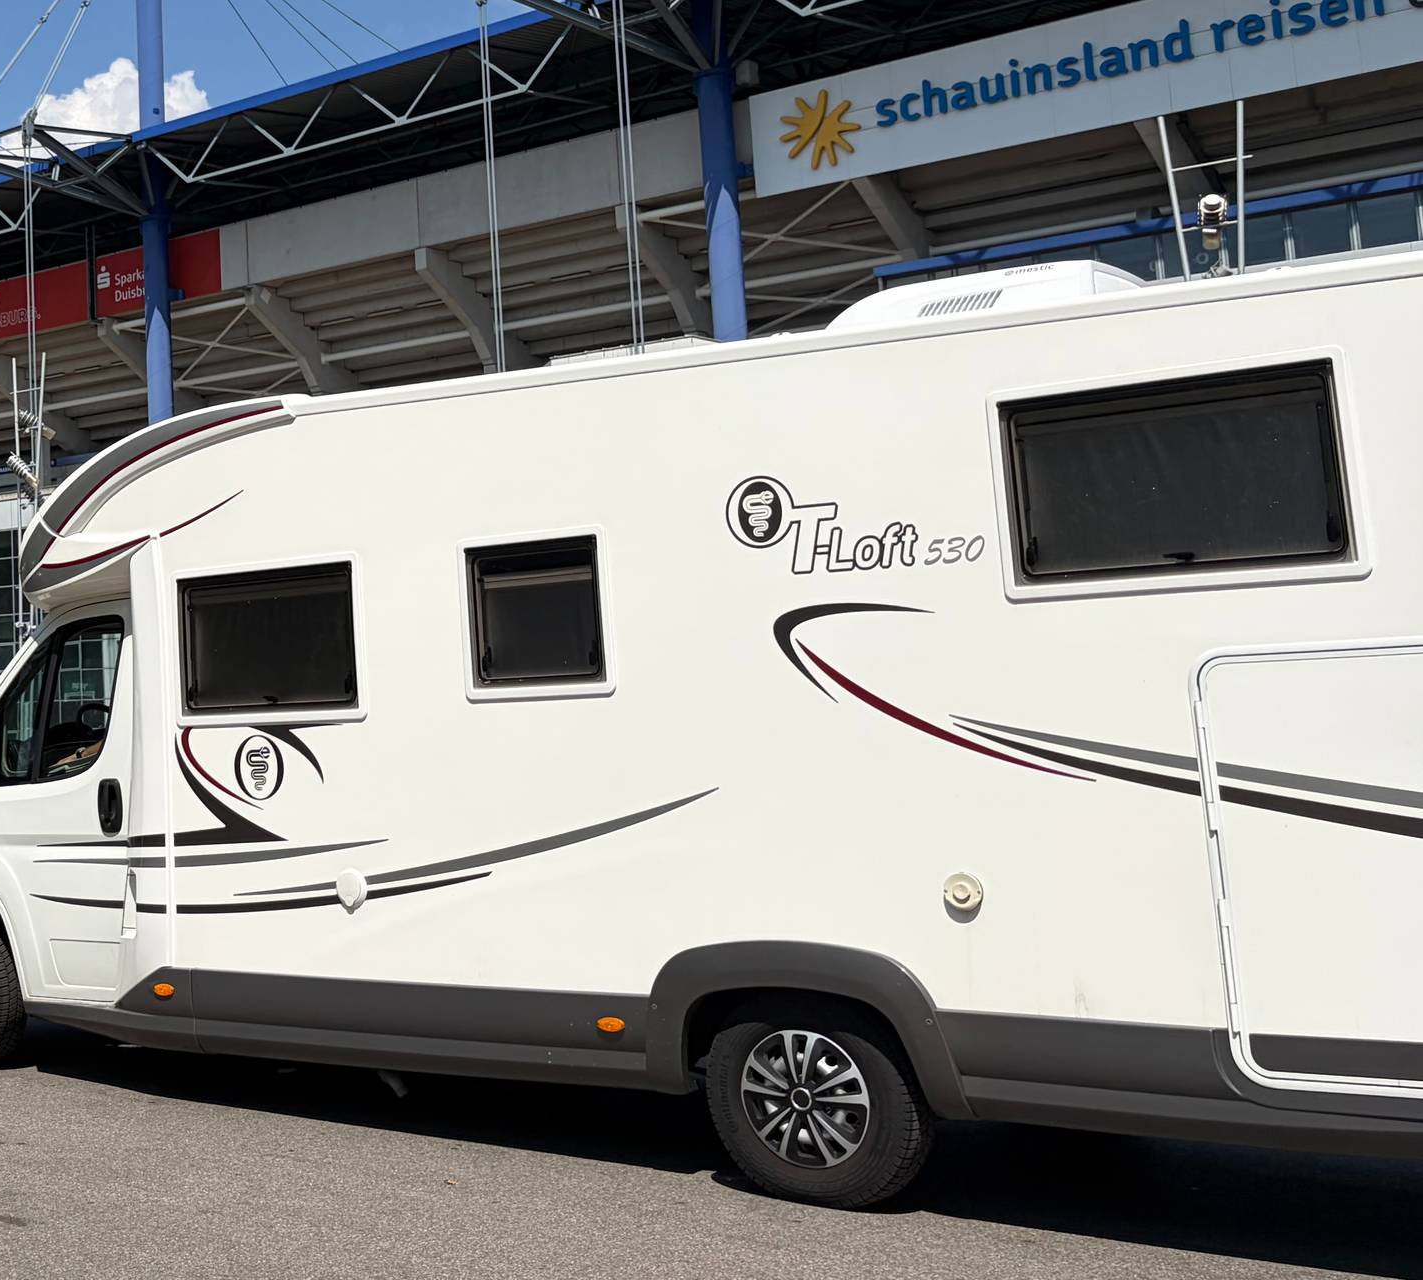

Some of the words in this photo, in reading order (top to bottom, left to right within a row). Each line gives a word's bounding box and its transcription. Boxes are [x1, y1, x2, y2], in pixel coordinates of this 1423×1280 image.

[876, 19, 1194, 127] schauinsland
[1211, 0, 1386, 53] reisen
[791, 502, 919, 575] T-Loft
[923, 535, 986, 566] 530
